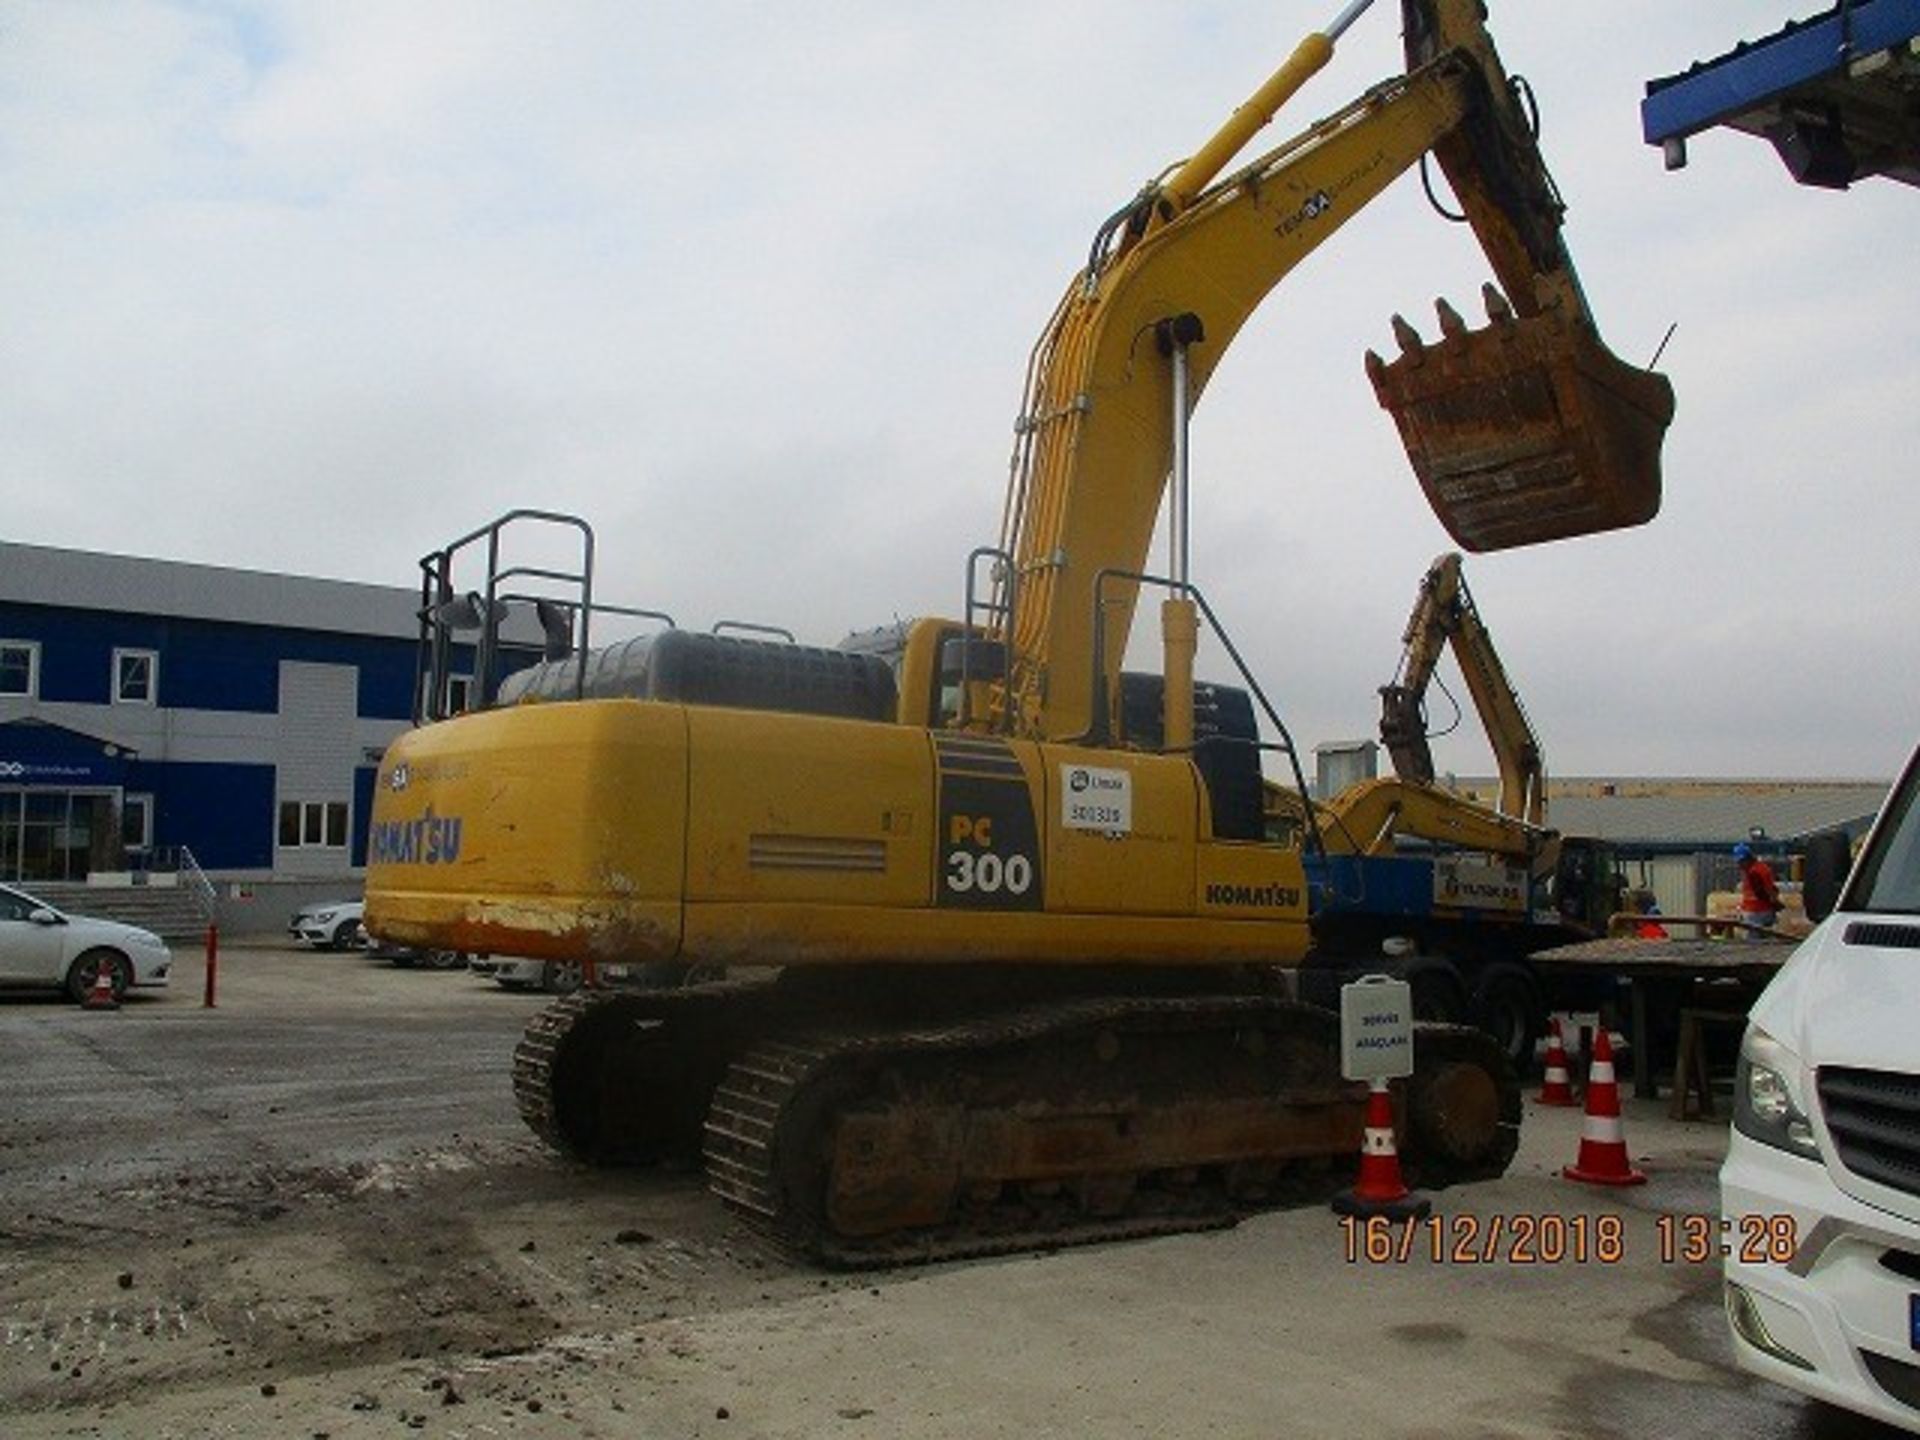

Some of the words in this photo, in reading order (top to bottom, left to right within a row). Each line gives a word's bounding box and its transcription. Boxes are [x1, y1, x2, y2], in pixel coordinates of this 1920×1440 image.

[950, 814, 992, 847] PC
[947, 851, 1032, 894] 300
[1206, 882, 1299, 906] KOMATSU
